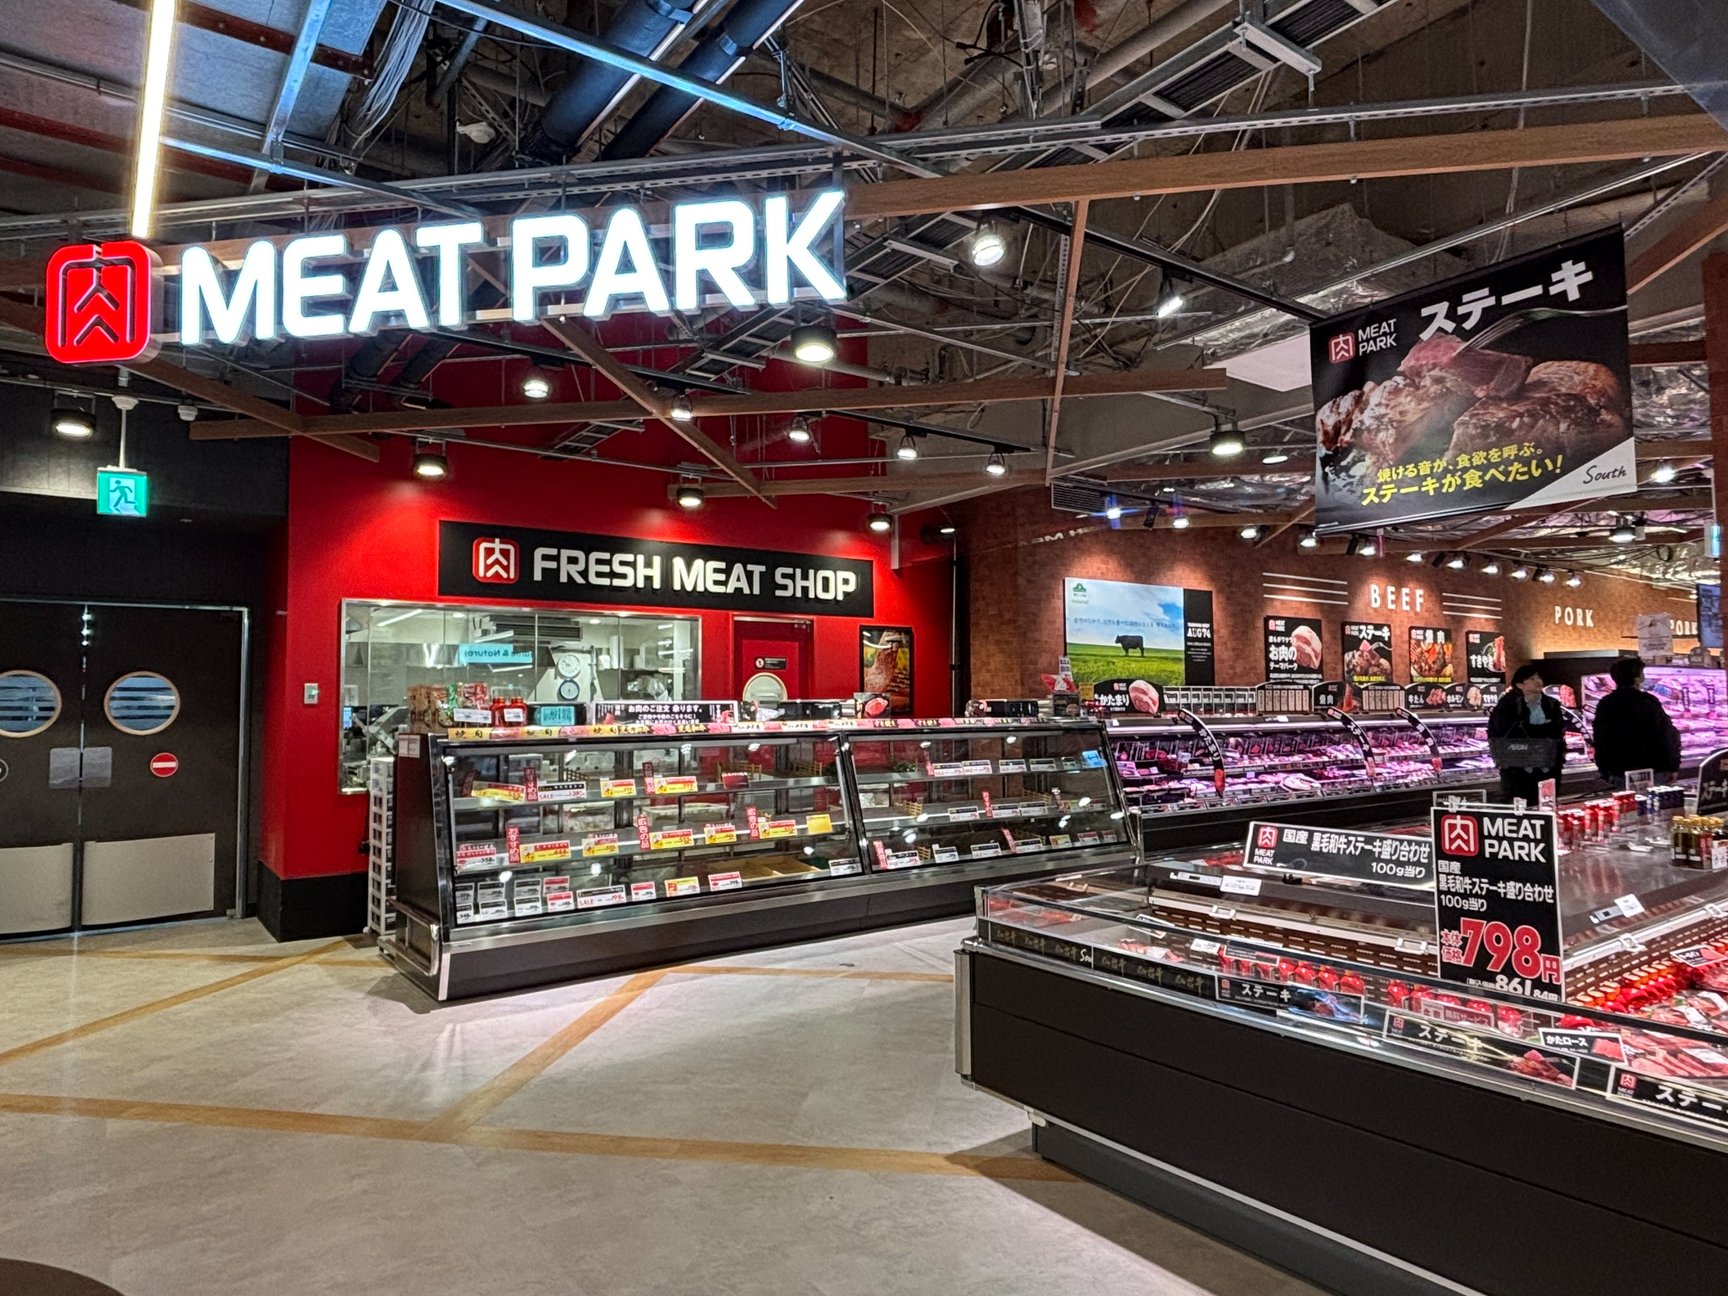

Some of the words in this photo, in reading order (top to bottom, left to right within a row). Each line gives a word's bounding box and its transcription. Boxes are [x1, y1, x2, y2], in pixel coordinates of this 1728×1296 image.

[181, 222, 485, 345] MEAT
[513, 190, 847, 322] PARK
[1419, 259, 1594, 342] ステーキ
[1358, 318, 1397, 342] MEAT
[1358, 332, 1397, 357] PARK
[1583, 465, 1627, 485] South
[534, 547, 661, 590] FRESH
[672, 556, 765, 595] MEAT
[774, 567, 857, 601] SHOP
[1370, 583, 1424, 613] BEEF
[1554, 606, 1594, 628] PORK
[1359, 625, 1390, 642] ステーキ
[1269, 645, 1297, 661] お肉の
[1347, 722, 1371, 752] ステーキ
[1483, 817, 1545, 839] MEAT
[1254, 848, 1275, 857] MEAT
[1282, 829, 1309, 844] 国産
[1311, 832, 1430, 863] 黒毛和牛ステーキ盛り合わせ
[1484, 840, 1546, 863] PARK
[1253, 855, 1273, 865] PARK
[1371, 862, 1426, 878] 100g当り
[1438, 860, 1461, 874] 国産
[1439, 874, 1554, 903] 黒毛和牛ステーキ盛り合わせ
[1440, 895, 1487, 911] 100g当り
[1242, 984, 1292, 1002] ステーキ
[1418, 1025, 1484, 1051] ステーキ
[1546, 1035, 1589, 1047] かたロース
[1655, 1085, 1728, 1112] ステー
